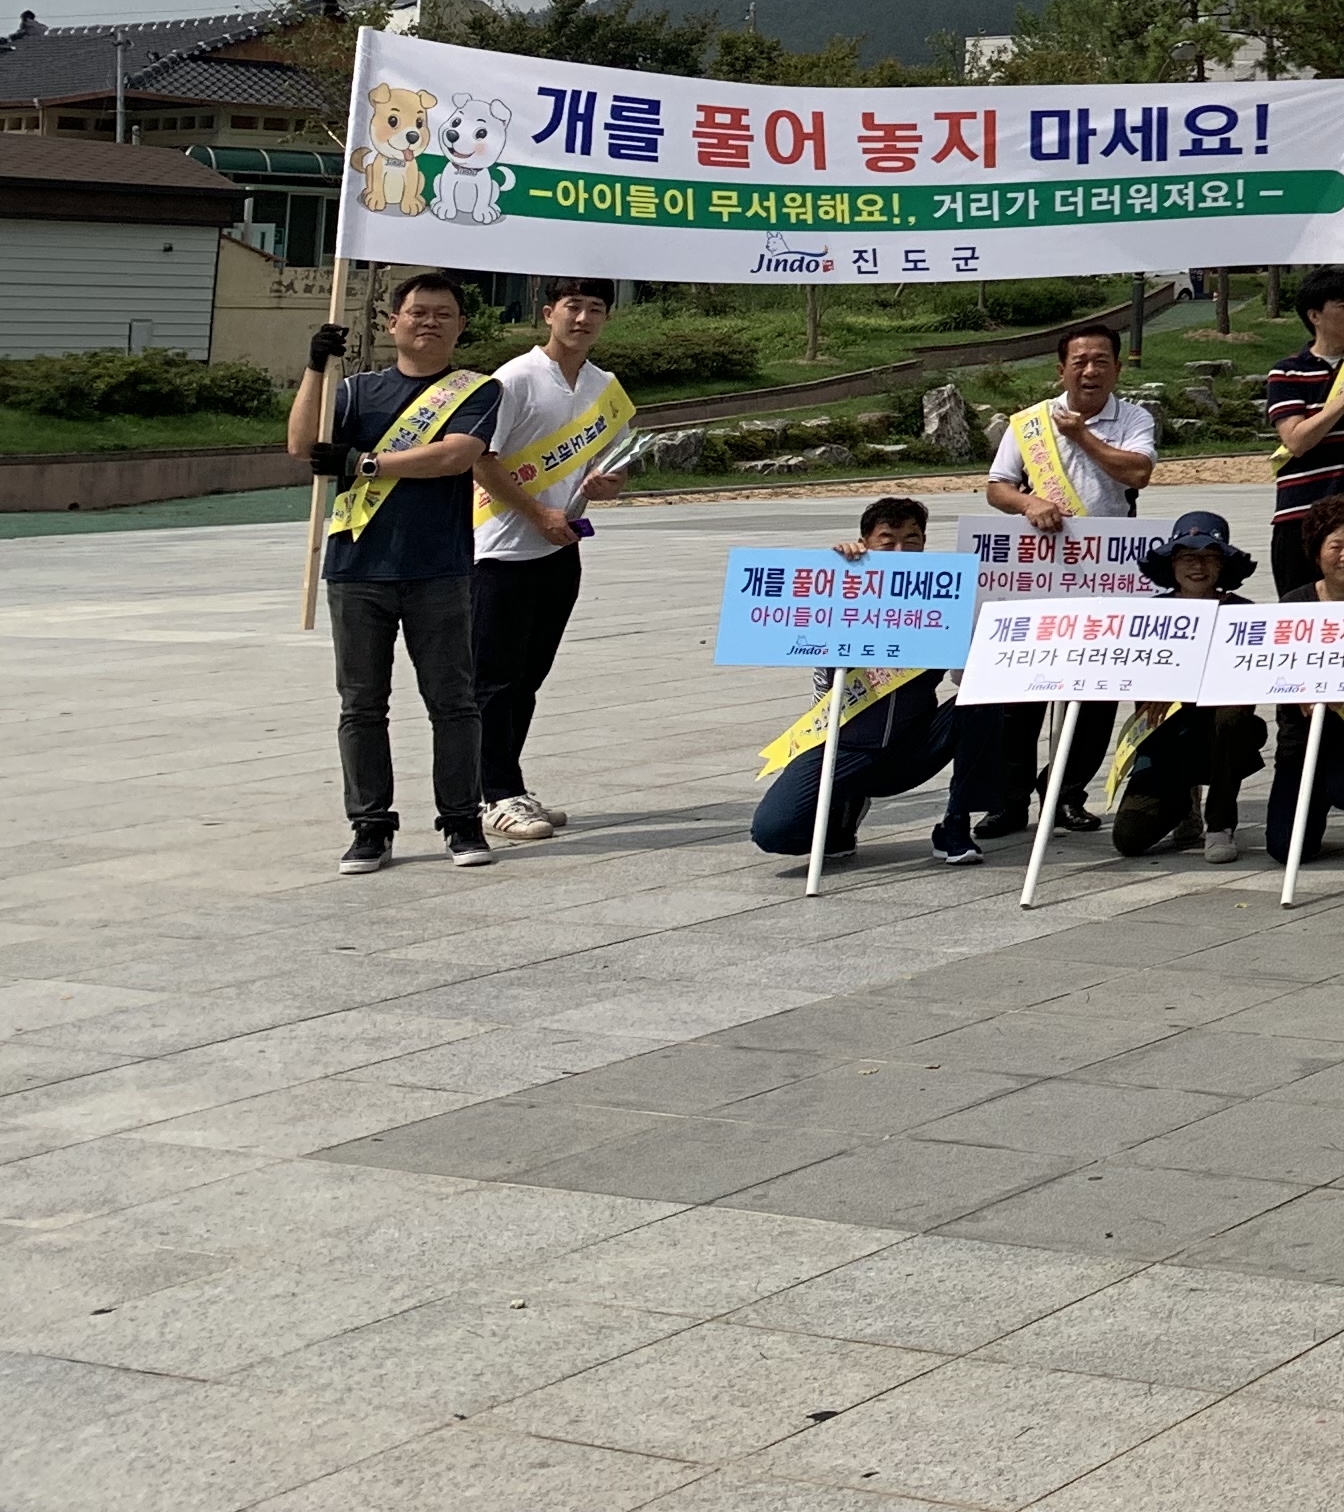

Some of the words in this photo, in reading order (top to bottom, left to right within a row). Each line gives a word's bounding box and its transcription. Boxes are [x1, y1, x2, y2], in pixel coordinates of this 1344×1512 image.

[531, 87, 664, 162] 개를
[692, 104, 826, 170] 풀어
[857, 110, 997, 173] 놓지
[1030, 103, 1269, 165] 마세요!
[933, 190, 1040, 223] 거리가
[1055, 179, 1245, 215] 더러워져요!
[750, 253, 819, 273] Jindo
[972, 534, 1010, 563] 개를
[1017, 535, 1056, 563] 풀어
[1063, 536, 1101, 565] 놓지
[741, 567, 785, 597] 개를
[792, 568, 836, 598] 풀어
[842, 569, 885, 599] 놓지
[890, 570, 962, 600] 마세요!
[978, 572, 1052, 592] 아이들이
[1059, 572, 1160, 593] 무서워해요.
[751, 606, 833, 628] 아이들이
[840, 608, 949, 630] 무서워해요.
[989, 617, 1031, 642] 개를
[1036, 615, 1079, 640] 풀어
[1083, 614, 1125, 641] 놓지
[1129, 615, 1199, 641] 마세요!
[1225, 620, 1267, 646] 개를
[1273, 618, 1314, 645] 풀어
[994, 648, 1058, 667] 거리가
[1066, 648, 1181, 667] 더러워져요.
[1233, 652, 1298, 671] 거리가
